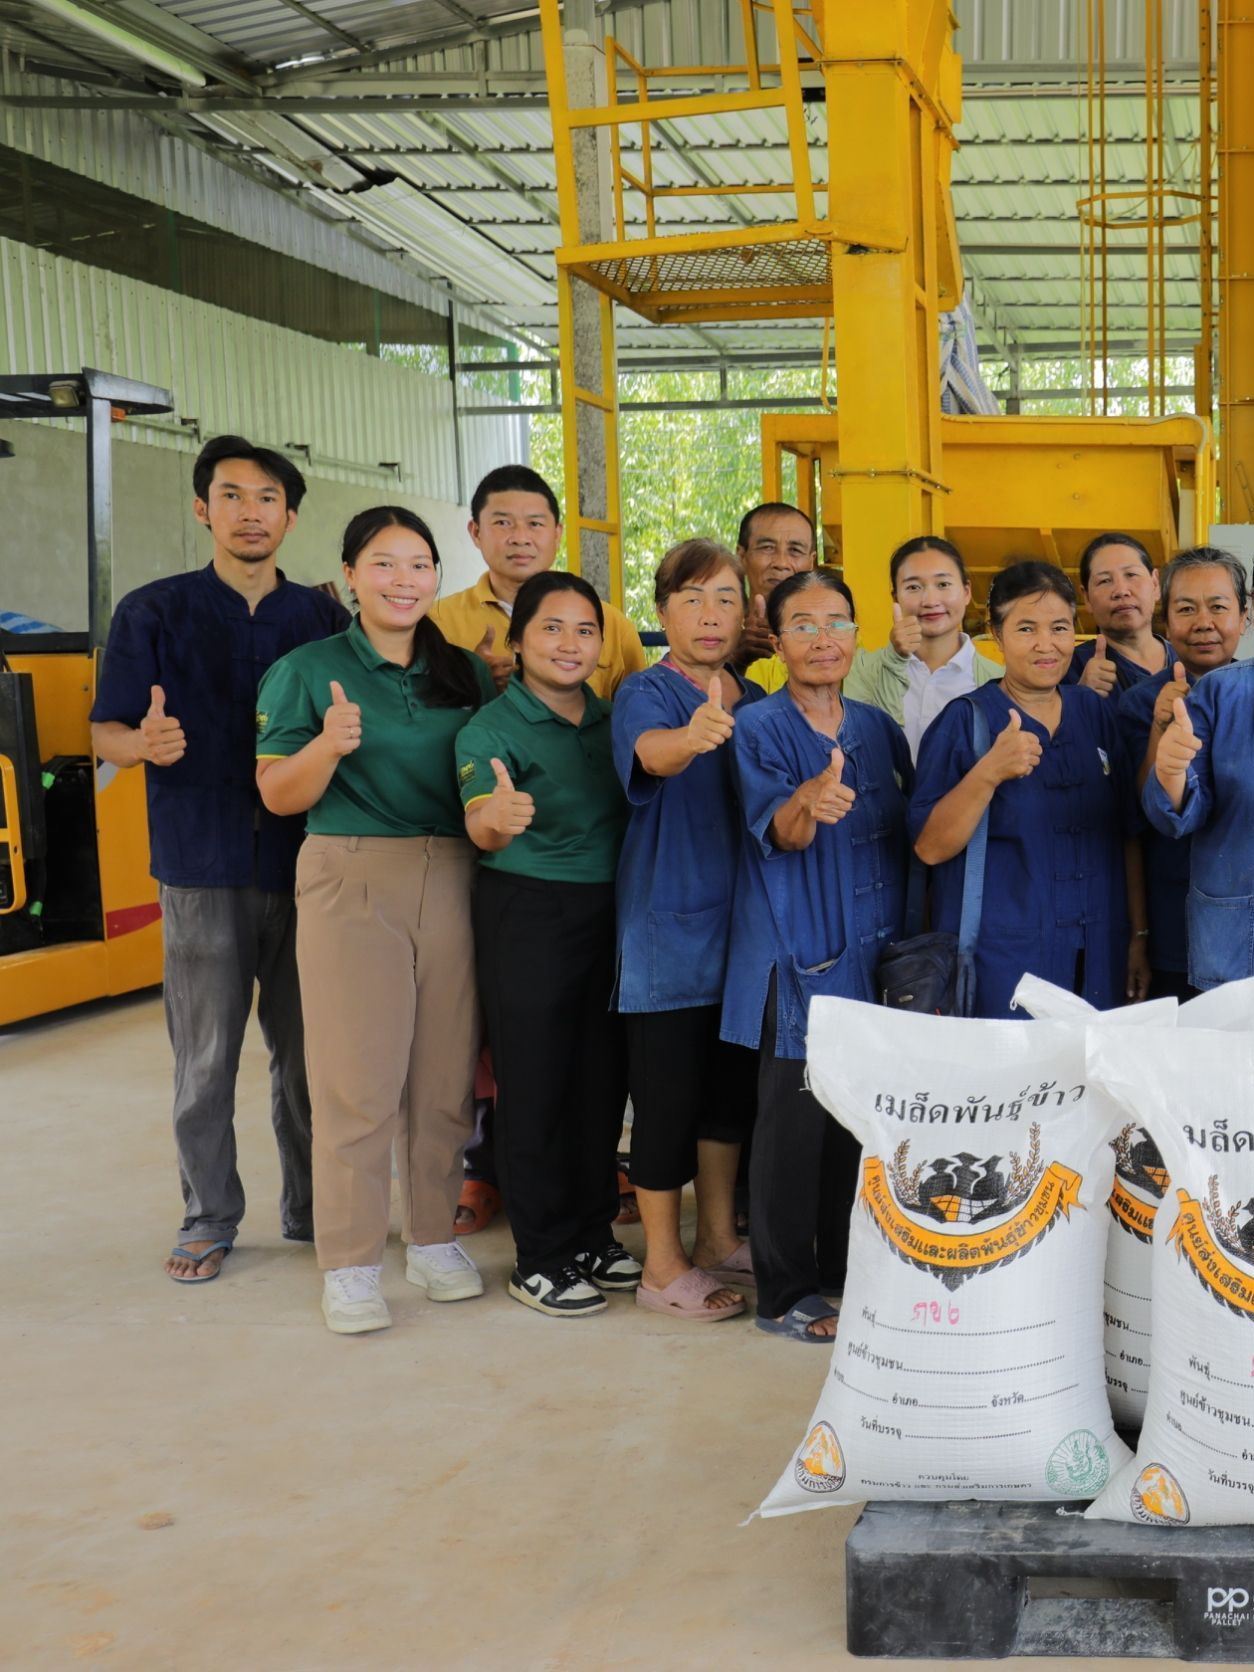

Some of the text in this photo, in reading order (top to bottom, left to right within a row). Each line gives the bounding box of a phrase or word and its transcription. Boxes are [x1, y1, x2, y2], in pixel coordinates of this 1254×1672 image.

[874, 1080, 1087, 1124] เมล็ดพันธุ์ข้าว
[892, 1392, 919, 1407] อำเภอ
[991, 1391, 1025, 1408] จังหวัด
[860, 1415, 902, 1440] วันที่บรรจุ
[1207, 1468, 1254, 1495] วันที่บรรจุ
[1203, 1612, 1250, 1620] PANACHAI
